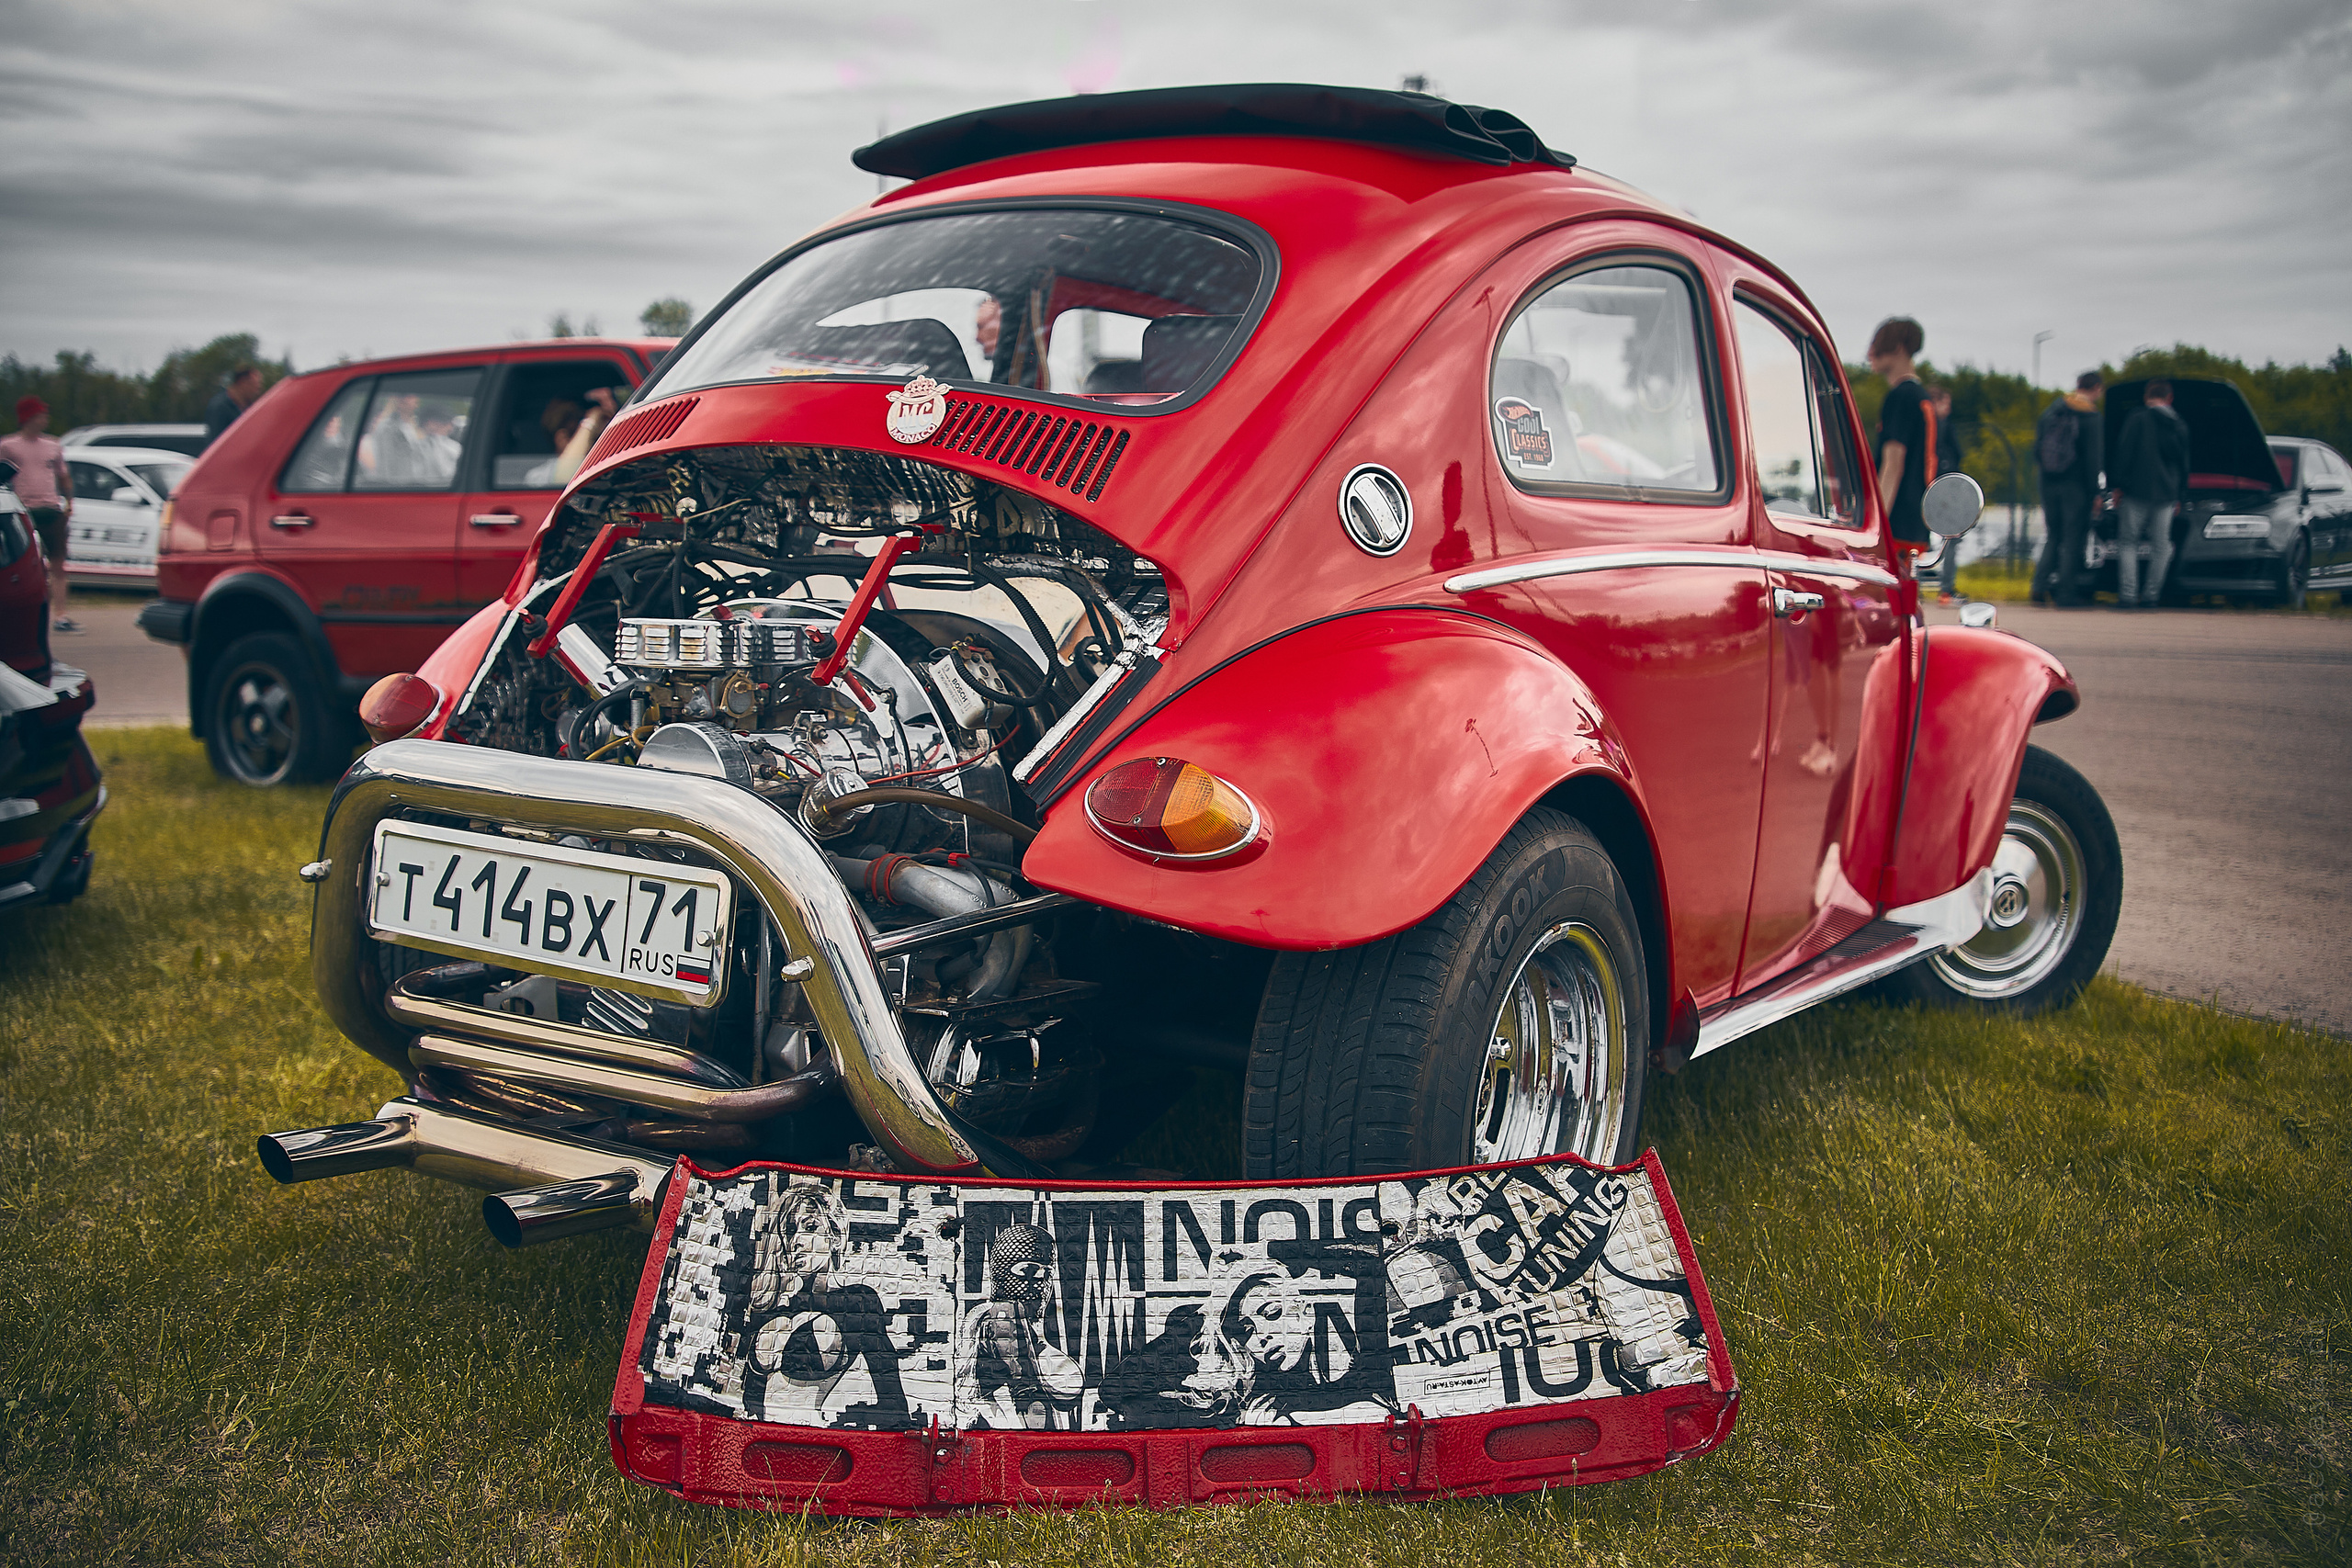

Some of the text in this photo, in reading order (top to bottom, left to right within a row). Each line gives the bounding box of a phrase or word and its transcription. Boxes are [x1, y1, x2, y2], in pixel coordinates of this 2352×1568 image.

[890, 423, 937, 443] MONACO
[951, 678, 968, 703] BOSCH
[639, 880, 698, 952] 71
[629, 948, 674, 976] RUS
[1415, 1304, 1556, 1366] NOISE
